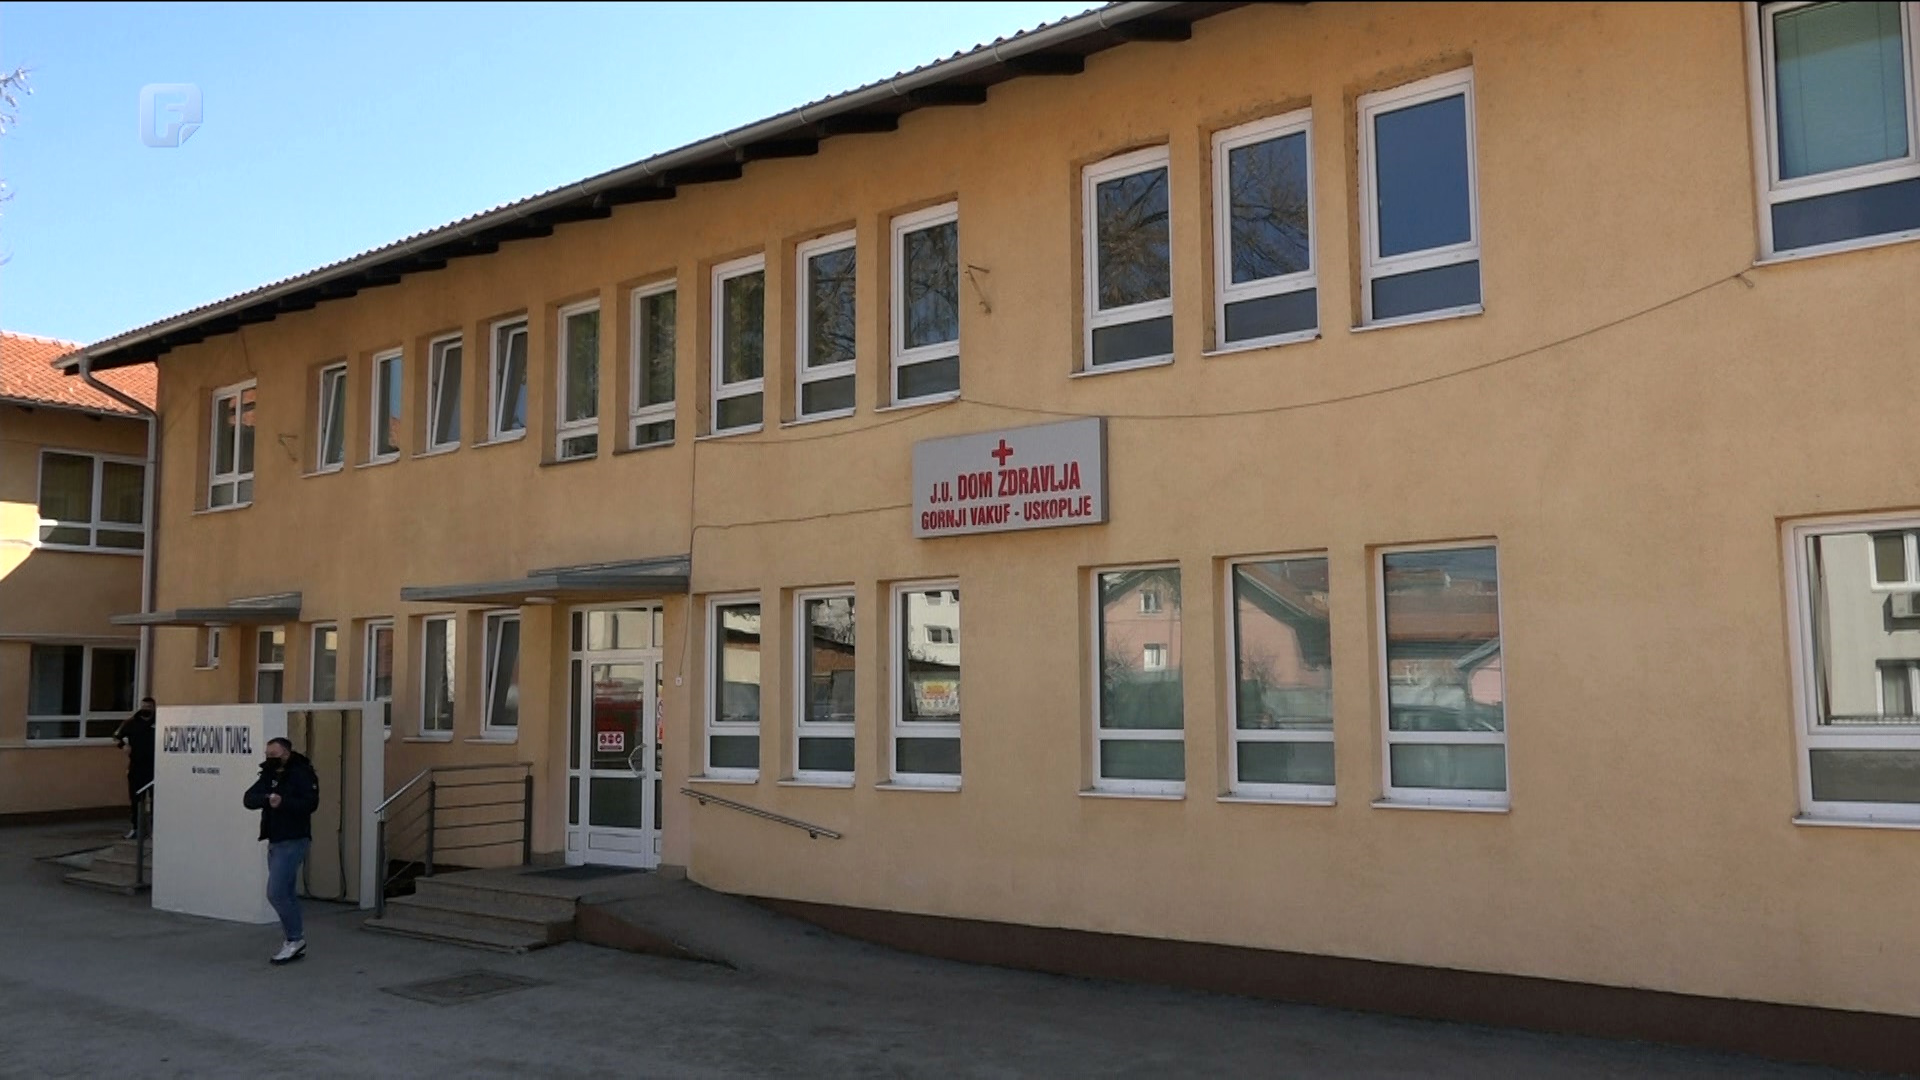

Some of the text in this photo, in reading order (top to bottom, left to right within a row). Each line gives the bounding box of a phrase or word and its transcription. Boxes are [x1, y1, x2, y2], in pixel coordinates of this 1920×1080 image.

[930, 461, 1081, 503] J.U. DOM ZDRAVLJA
[921, 507, 967, 530] GORNJI
[970, 503, 1010, 525] VAKUF
[1023, 495, 1092, 521] USKOPLJE
[225, 726, 252, 754] TUNEL
